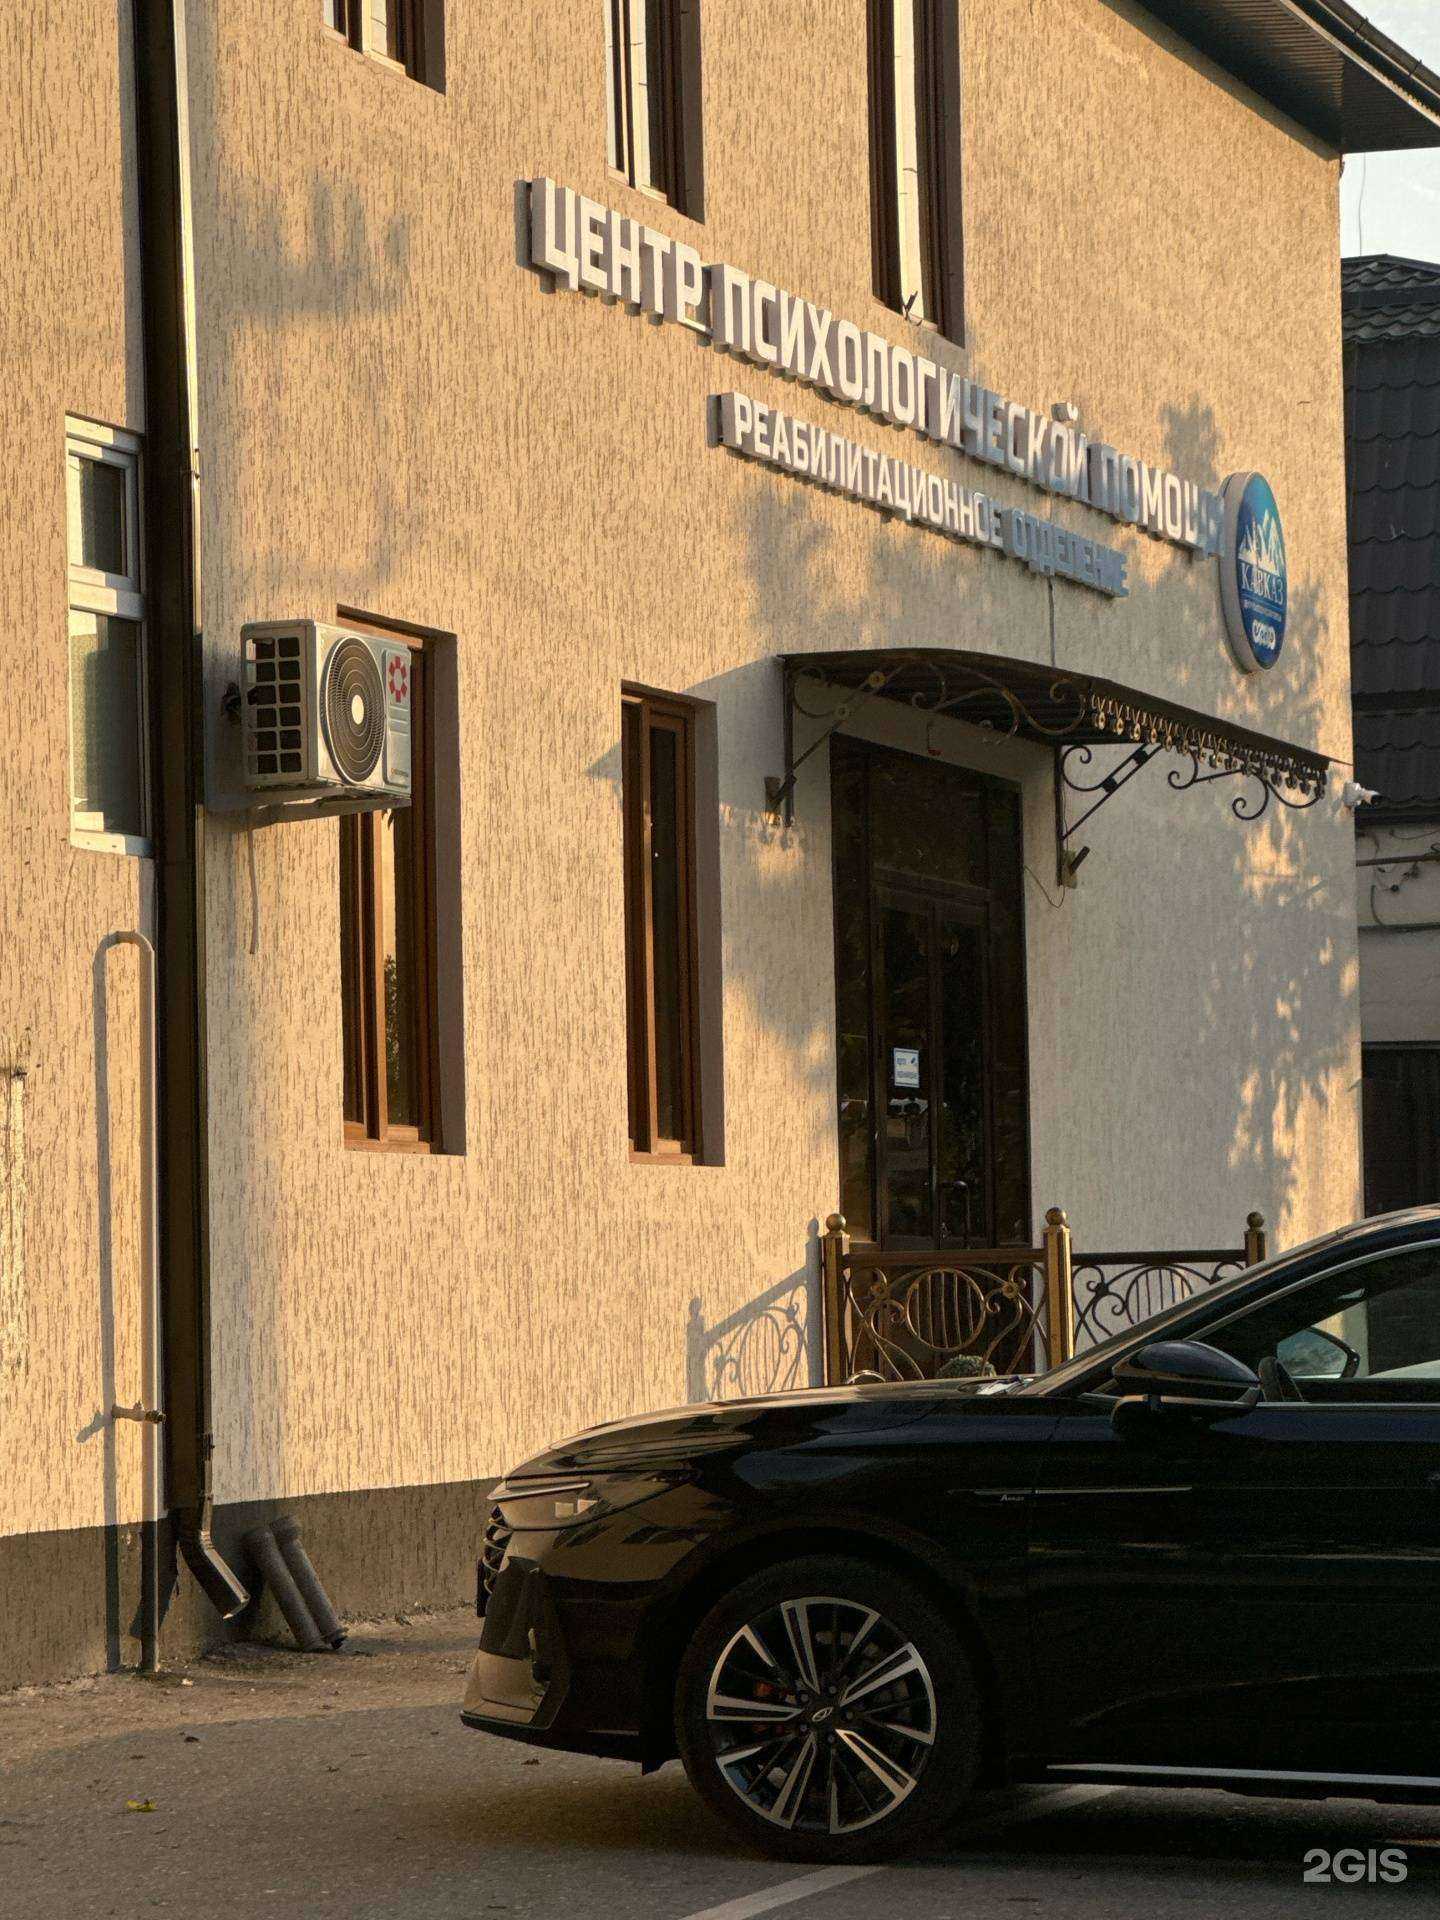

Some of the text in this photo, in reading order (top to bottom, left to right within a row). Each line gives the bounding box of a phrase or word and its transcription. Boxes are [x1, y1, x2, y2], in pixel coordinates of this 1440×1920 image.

[534, 176, 705, 332] ЦЕНТР
[713, 263, 1090, 501] ПСИХОЛОГИЧЕСКОЙ
[724, 391, 1003, 549] РЕАБИЛИТАЦИОННОЕ
[1241, 562, 1284, 605] КАВКАЗ
